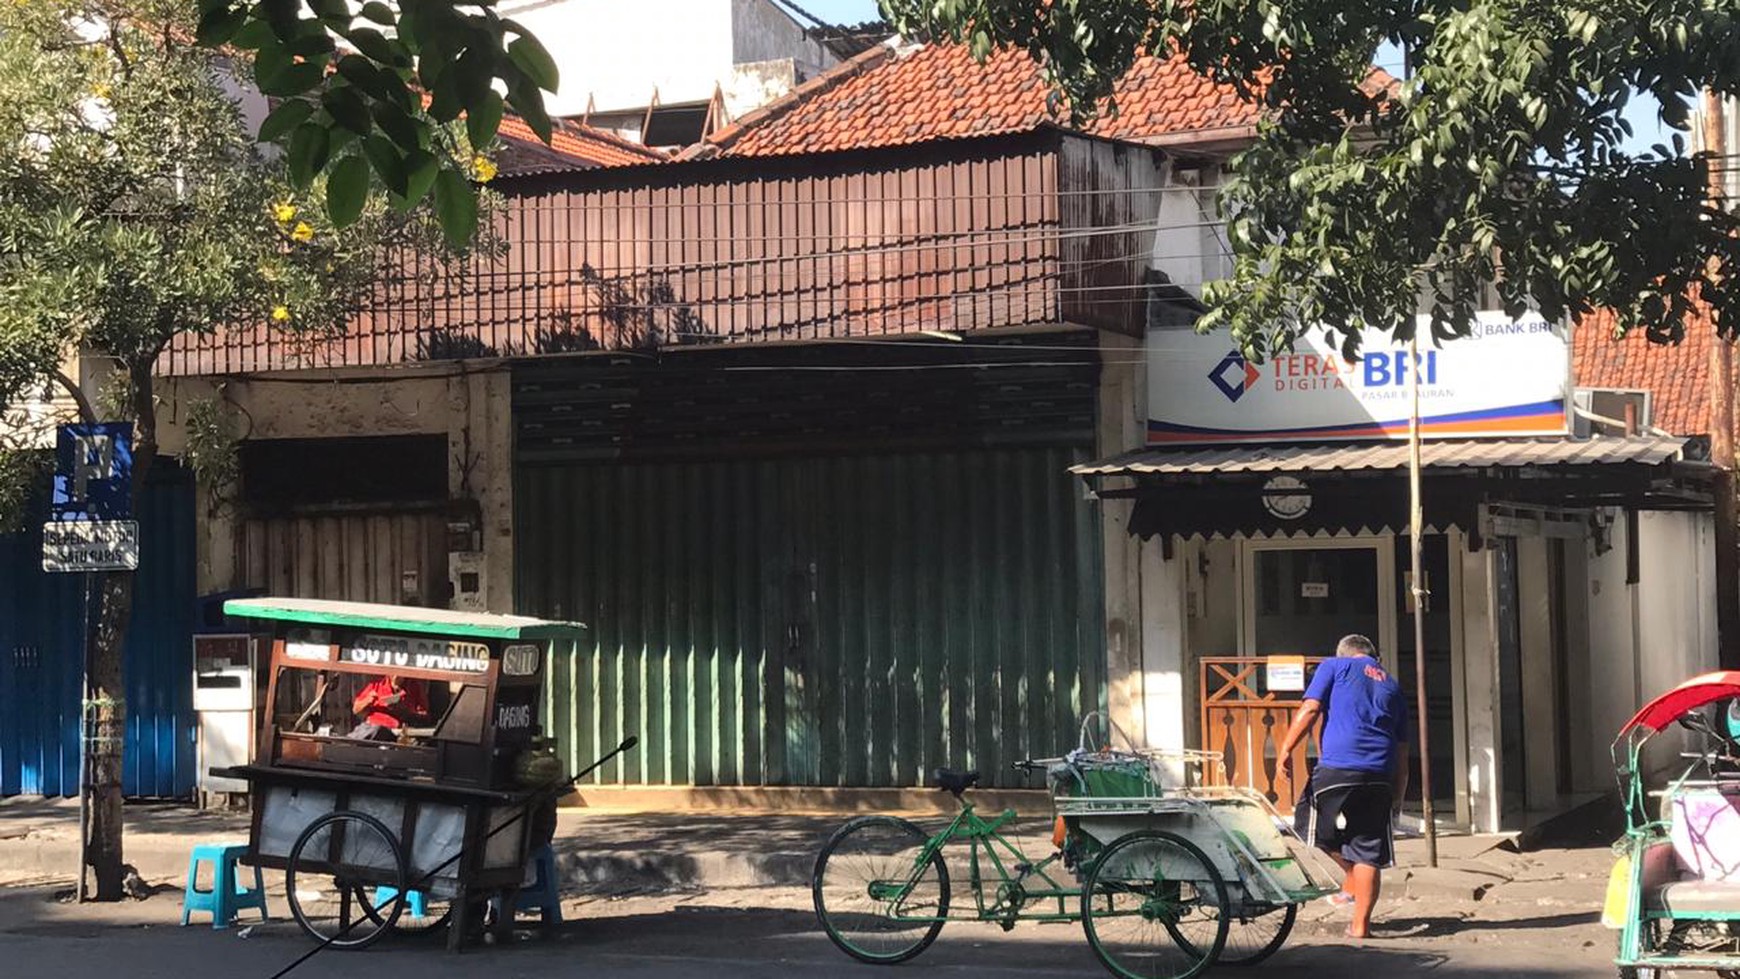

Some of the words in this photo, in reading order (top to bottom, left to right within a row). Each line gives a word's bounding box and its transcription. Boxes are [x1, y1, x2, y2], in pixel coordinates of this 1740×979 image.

[1485, 323, 1525, 336] BANK
[1363, 350, 1437, 387] BRI
[1361, 391, 1398, 400] PASAR
[1401, 388, 1455, 400] BAURAN
[74, 434, 113, 502] P
[351, 638, 409, 666] SOTO
[416, 641, 490, 674] DAGING
[499, 704, 530, 730] DAGING
